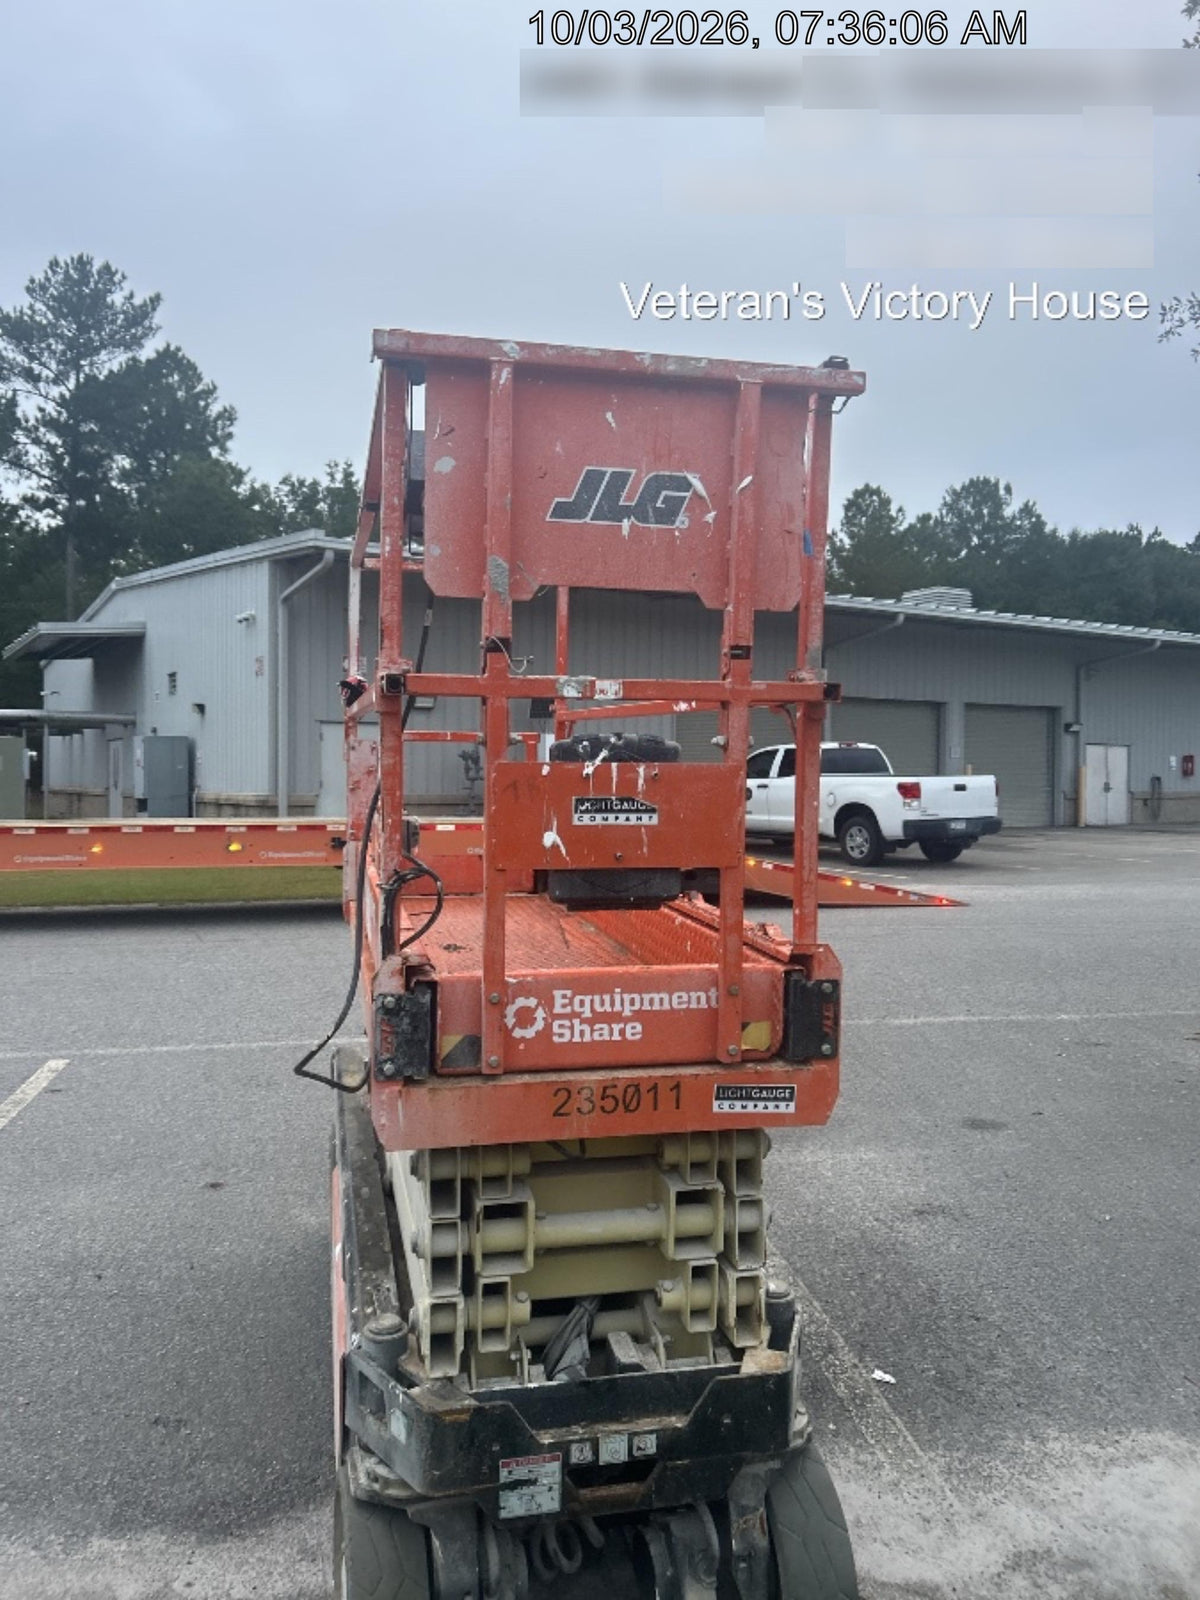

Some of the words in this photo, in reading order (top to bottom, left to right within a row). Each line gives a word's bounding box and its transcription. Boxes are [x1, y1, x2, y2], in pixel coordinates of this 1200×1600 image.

[545, 466, 700, 528] JLG
[552, 987, 720, 1017] Equipment
[552, 1018, 643, 1044] Share
[552, 1081, 682, 1117] 235011
